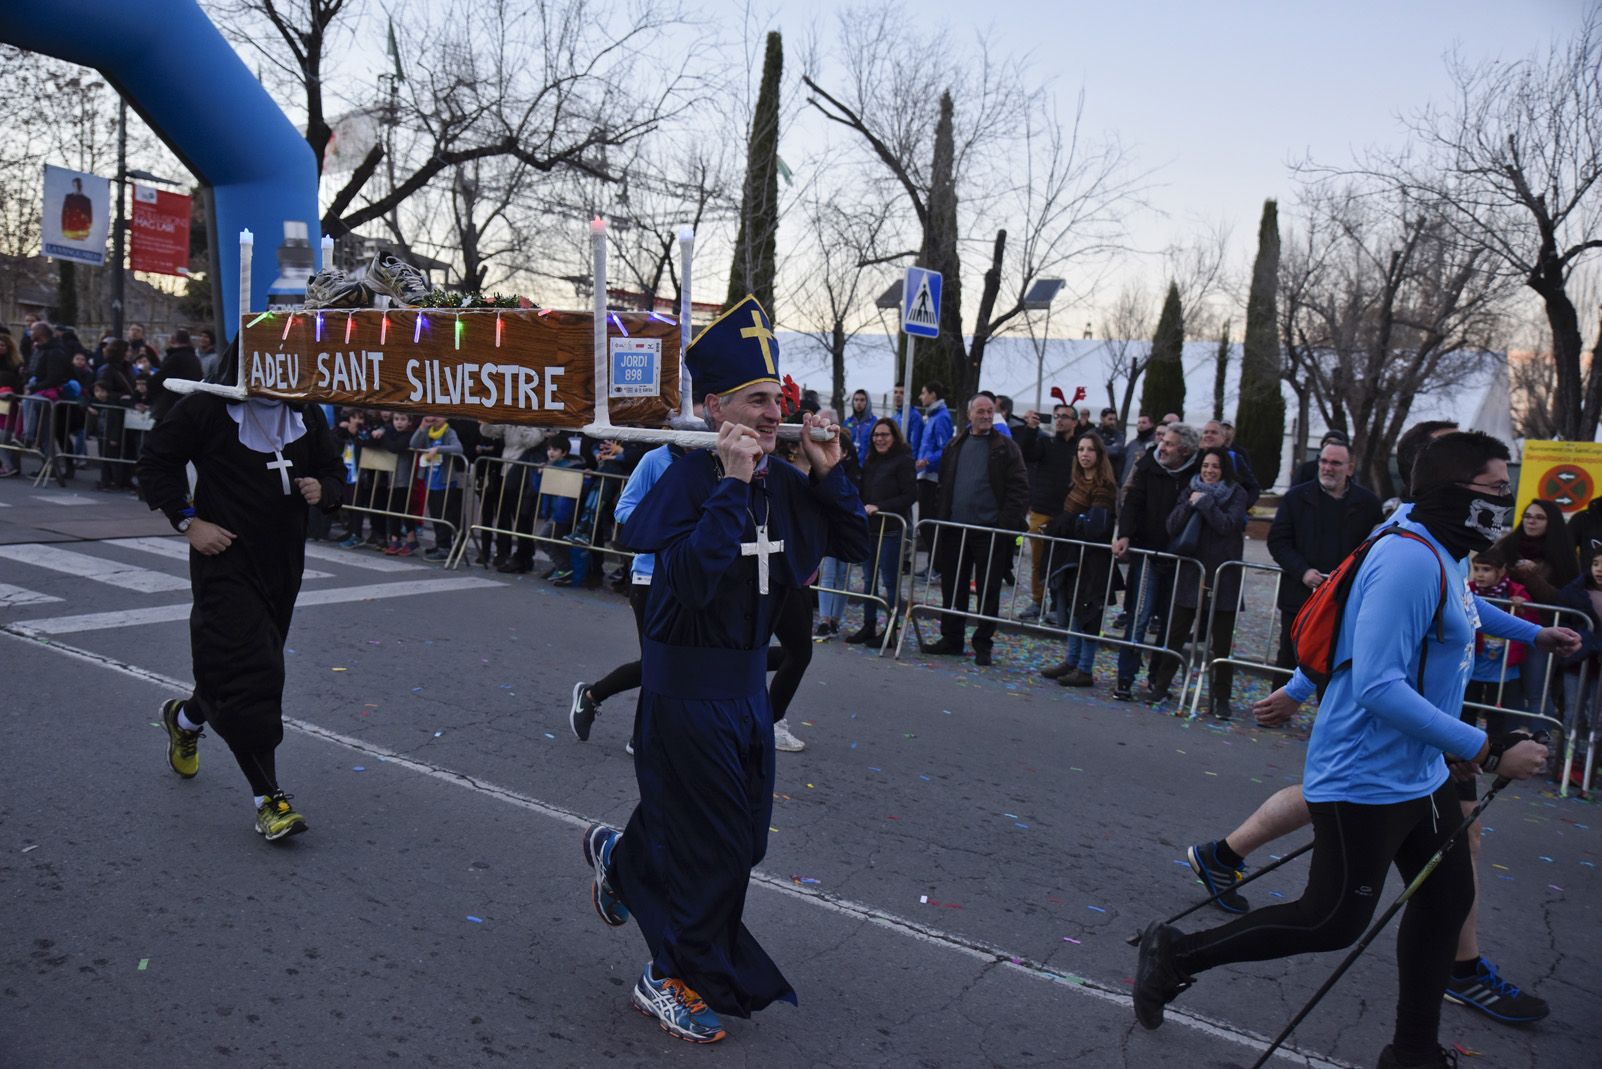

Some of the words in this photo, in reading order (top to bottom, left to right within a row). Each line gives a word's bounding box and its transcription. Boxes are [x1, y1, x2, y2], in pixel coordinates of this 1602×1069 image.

[620, 355, 648, 368] JORDI
[251, 343, 299, 390] ADÉU
[317, 350, 384, 391] SANT
[406, 358, 565, 411] SILVESTRE
[625, 368, 642, 381] 898
